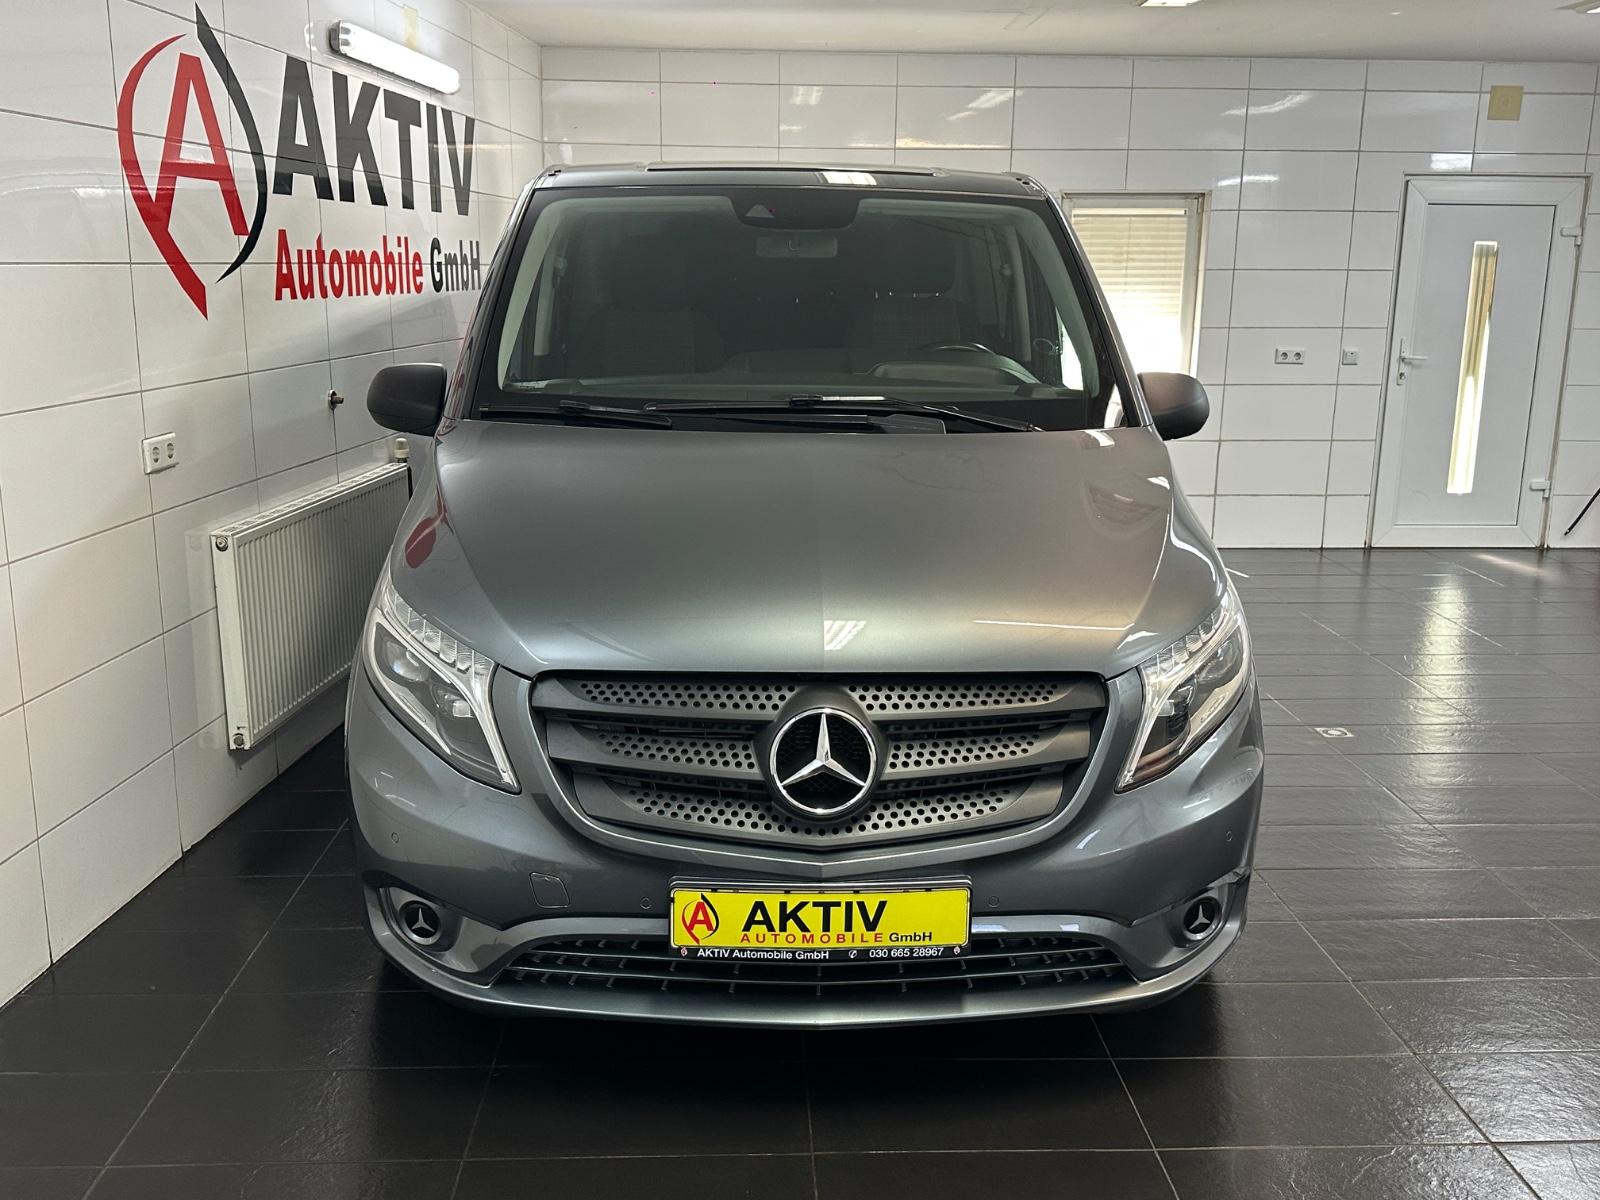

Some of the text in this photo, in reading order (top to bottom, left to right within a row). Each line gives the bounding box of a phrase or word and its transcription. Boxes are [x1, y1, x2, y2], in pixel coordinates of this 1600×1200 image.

[272, 55, 475, 216] AKTIV
[275, 228, 481, 301] Automobile GmbH
[742, 900, 887, 932] AKTIV
[697, 947, 943, 960] AKTIV Automobile GmbH 030 665 28967
[740, 932, 932, 944] AUTOMOBILE GmbH
